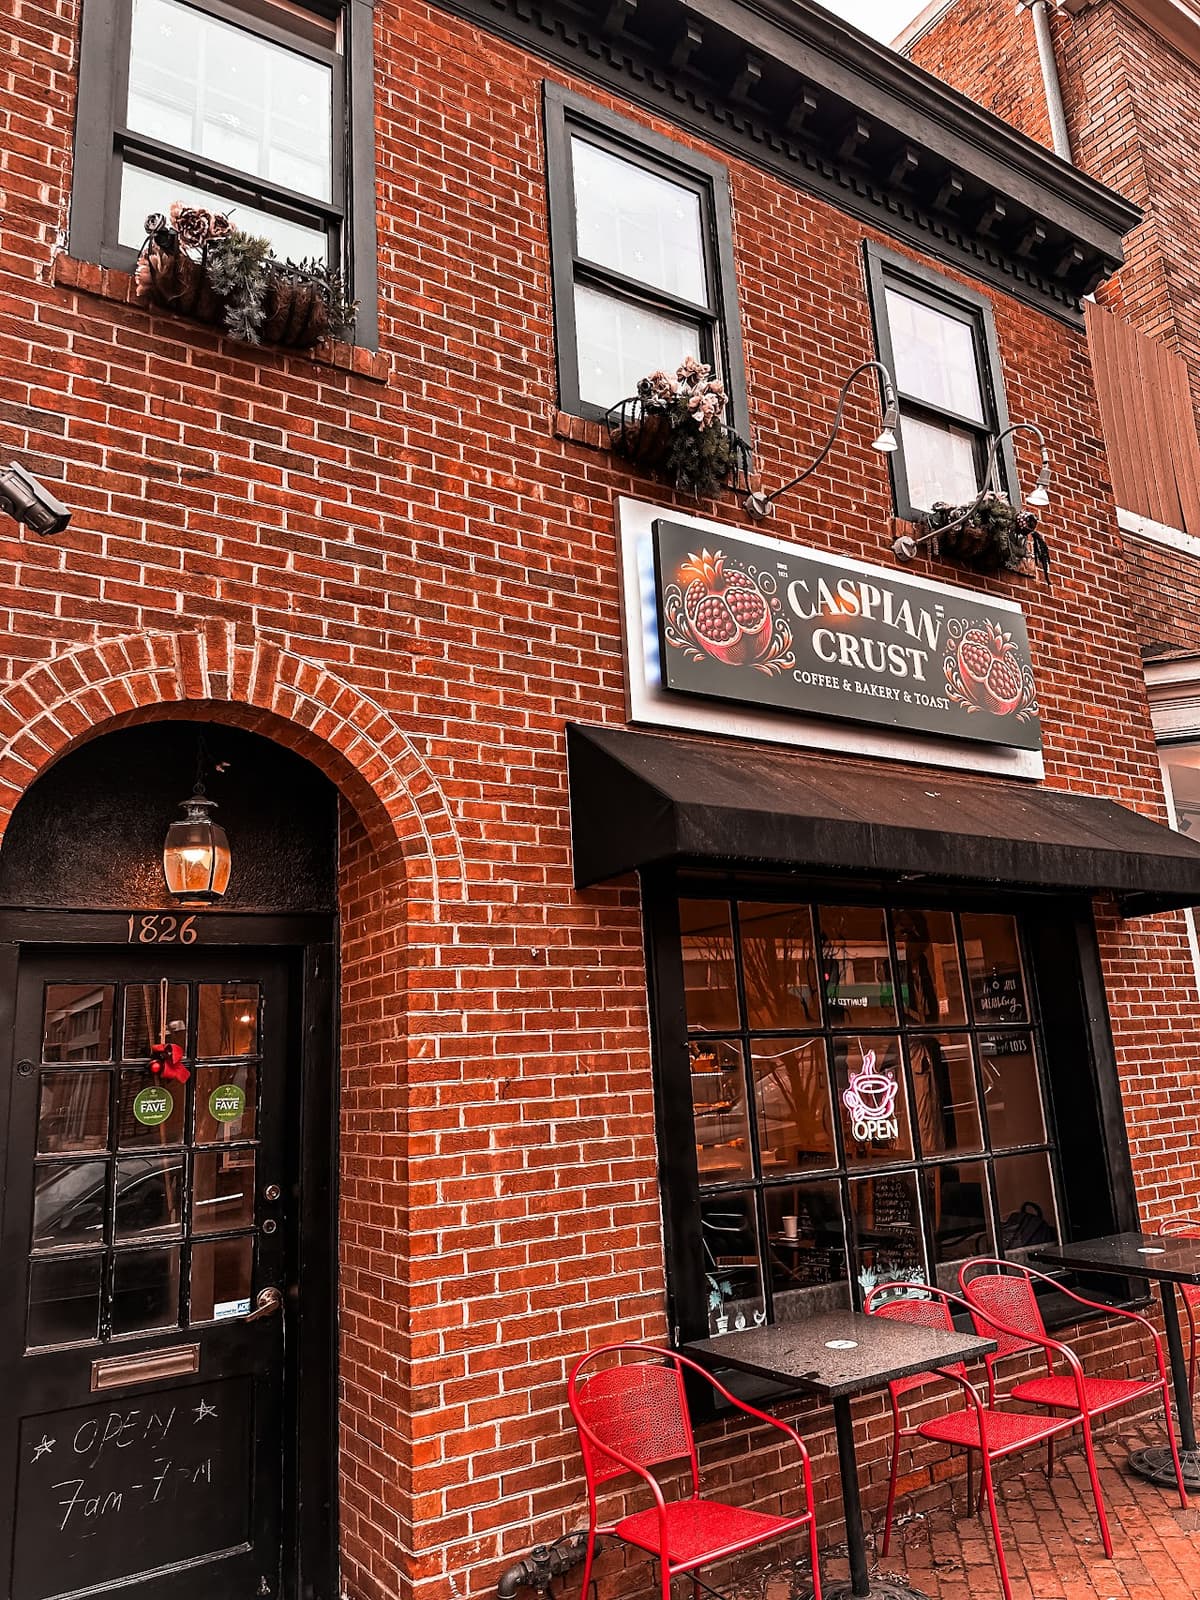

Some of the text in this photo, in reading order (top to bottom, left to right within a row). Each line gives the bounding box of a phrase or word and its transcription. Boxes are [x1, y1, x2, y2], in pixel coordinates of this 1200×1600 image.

[787, 577, 942, 651] CASPIAN
[812, 628, 929, 682] CRUST
[793, 670, 951, 710] COFFEE & BAKERY & TOAST
[128, 914, 198, 944] 1826
[140, 1102, 167, 1114] FAVE
[215, 1100, 240, 1111] FAVE
[854, 1119, 899, 1140] OPEN
[73, 1407, 176, 1469] OPEN
